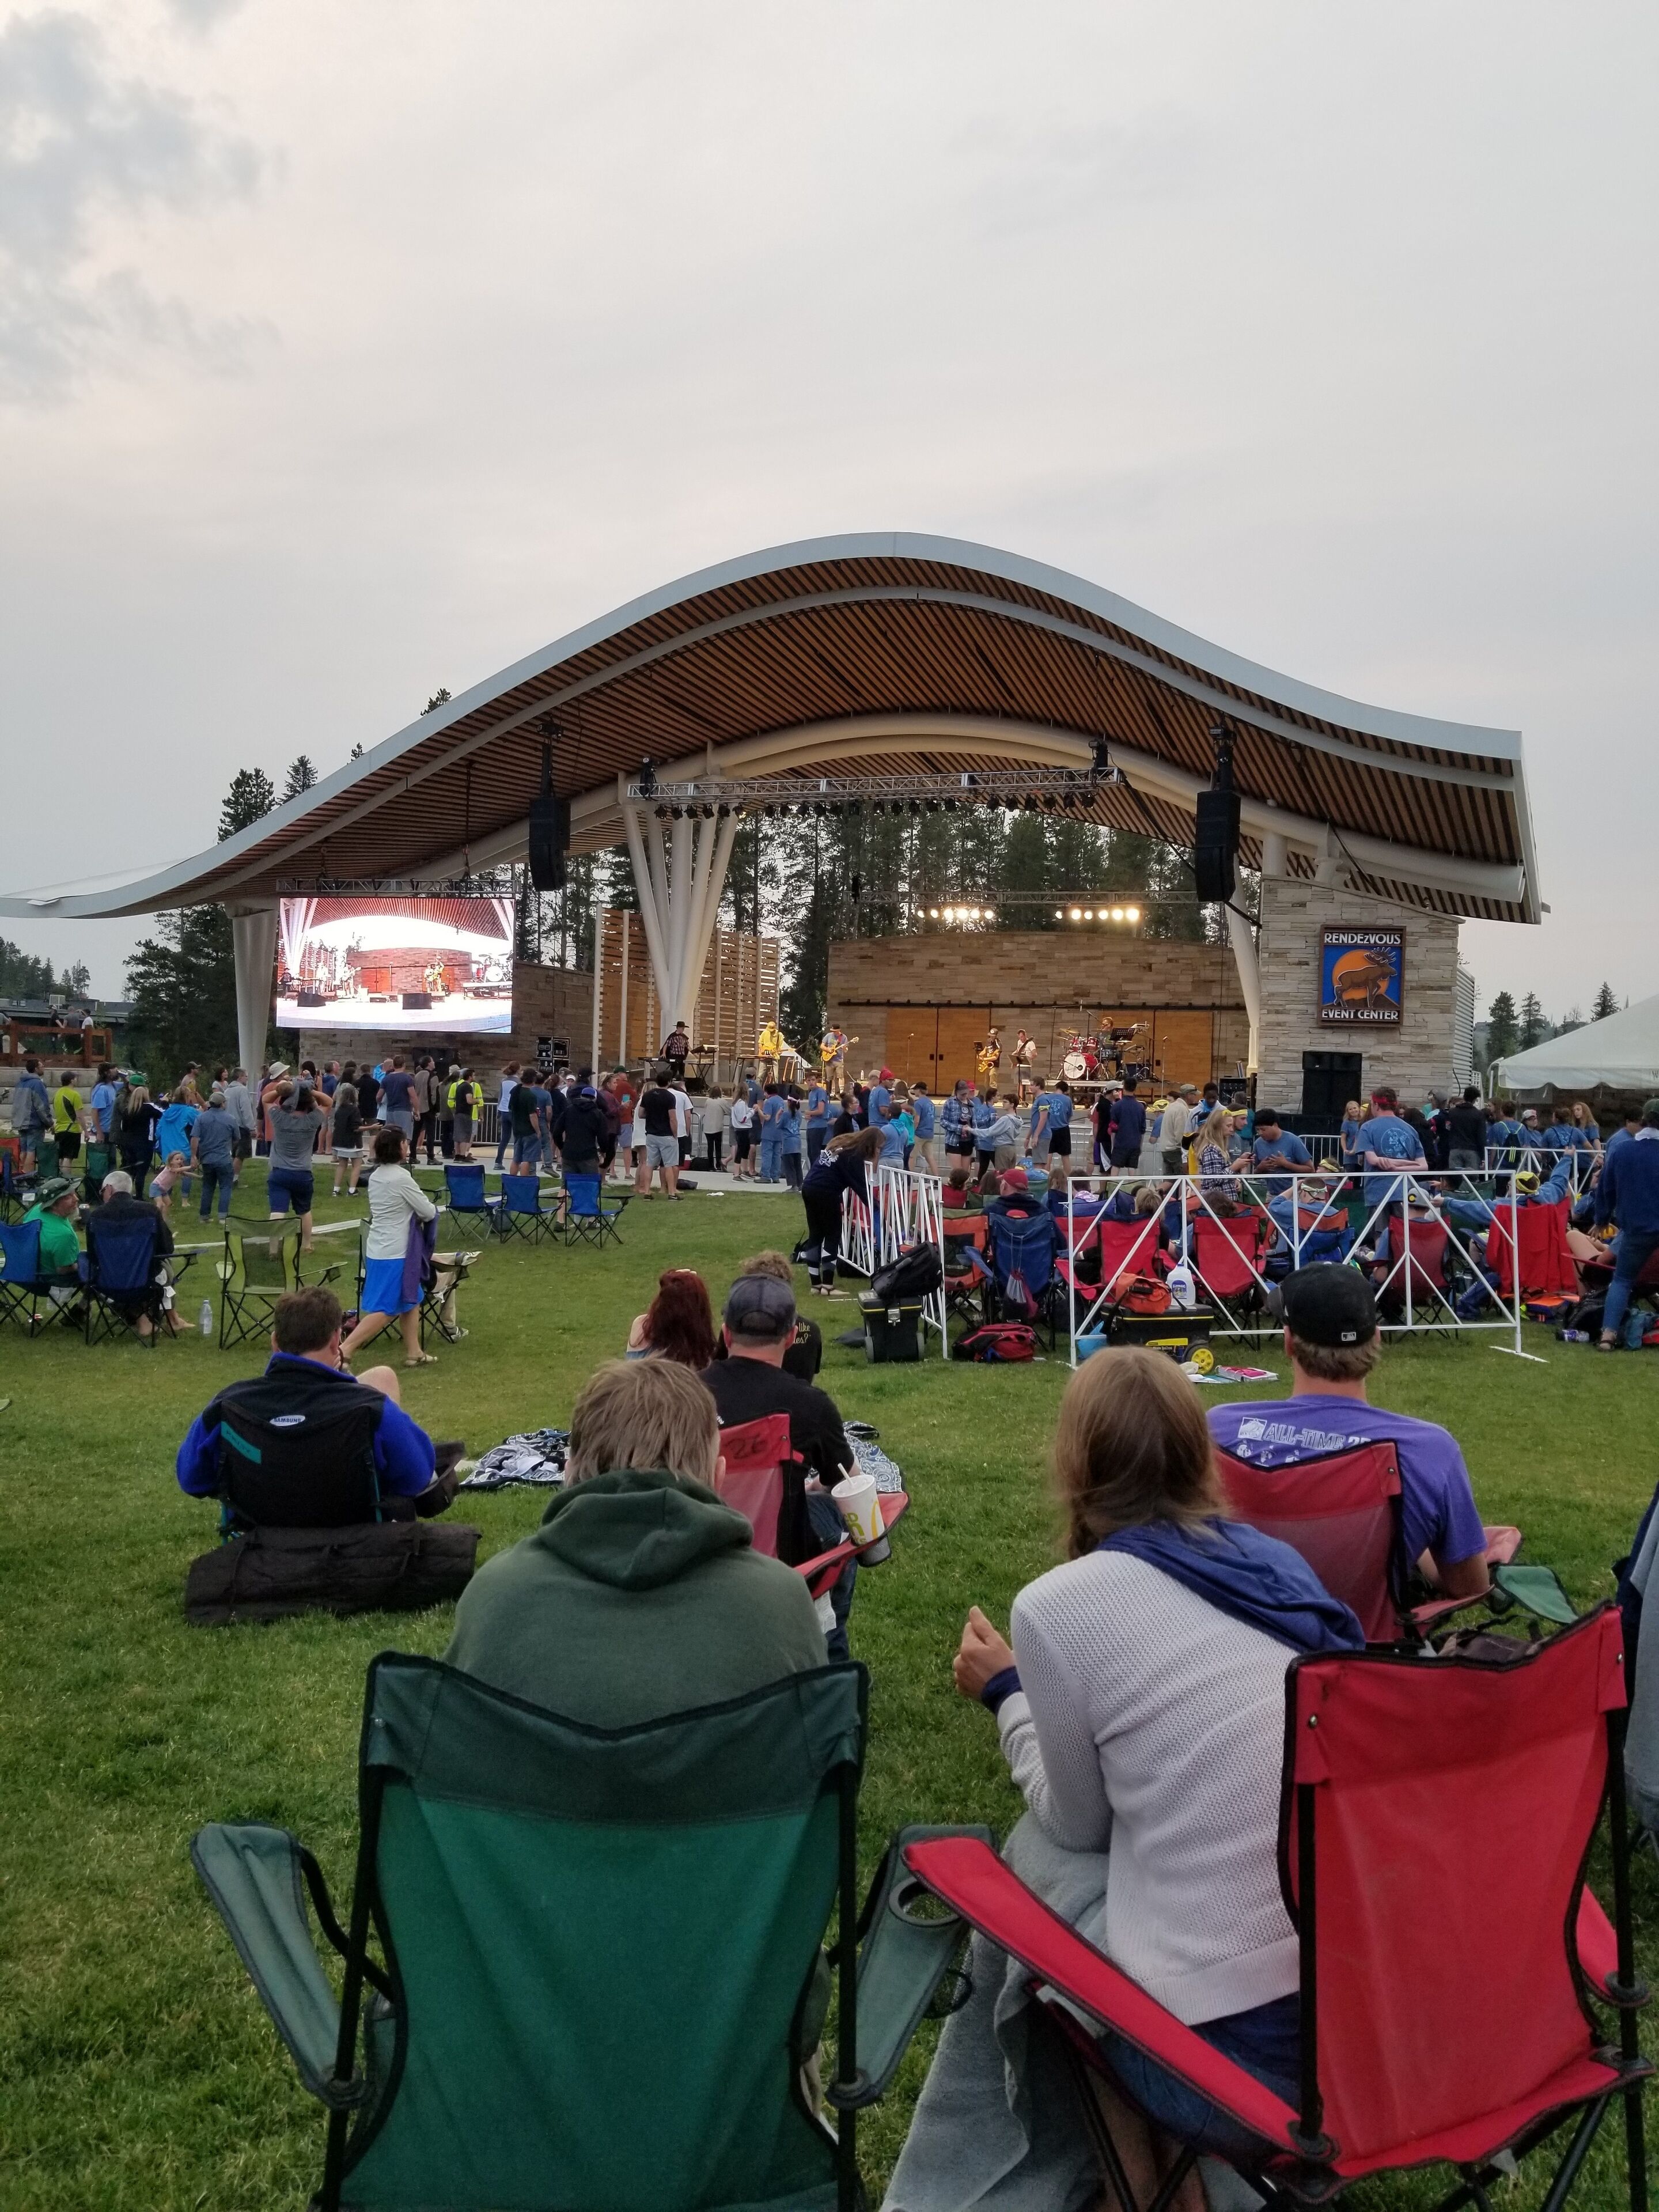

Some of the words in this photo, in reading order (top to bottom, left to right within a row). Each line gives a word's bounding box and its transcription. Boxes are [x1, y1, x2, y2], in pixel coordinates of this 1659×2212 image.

[1321, 1009, 1356, 1019] EVENT
[1357, 1010, 1399, 1020] CENTER
[798, 1321, 810, 1332] like
[1263, 1423, 1346, 1450] ALL-TIME
